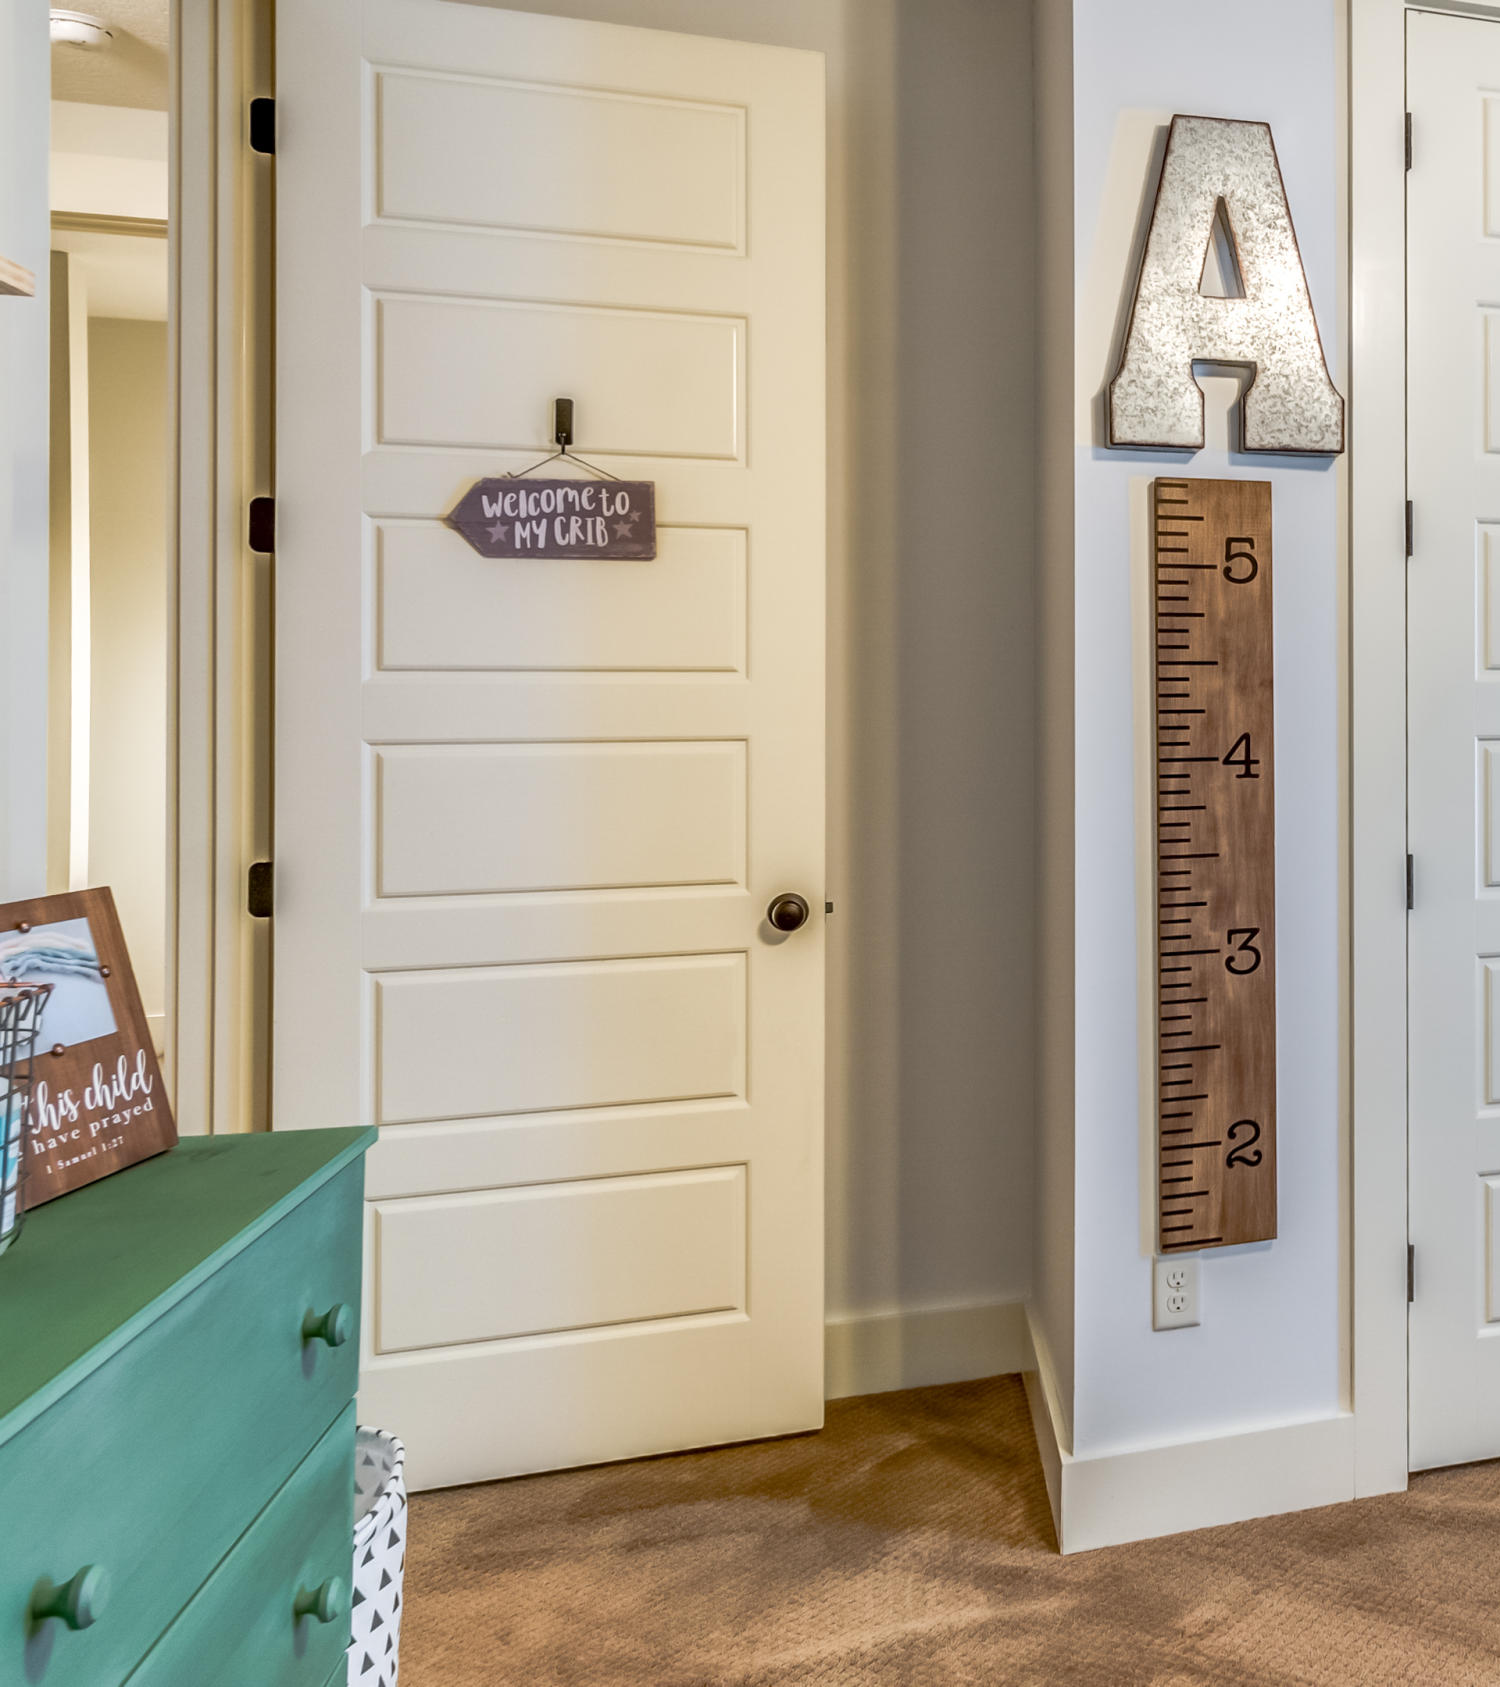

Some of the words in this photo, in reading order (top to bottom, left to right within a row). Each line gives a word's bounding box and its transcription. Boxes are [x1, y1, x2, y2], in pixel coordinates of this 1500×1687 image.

[598, 487, 630, 517] to
[514, 518, 547, 549] MY
[554, 516, 608, 547] CRIB
[1223, 537, 1258, 584] 5
[1222, 732, 1260, 779] 4
[1225, 927, 1261, 975] 3
[84, 1048, 153, 1110] child
[31, 1128, 81, 1155] have
[89, 1097, 153, 1137] prayed
[1226, 1119, 1263, 1169] 2
[57, 1146, 97, 1169] Samuel
[101, 1135, 124, 1152] 1:27
